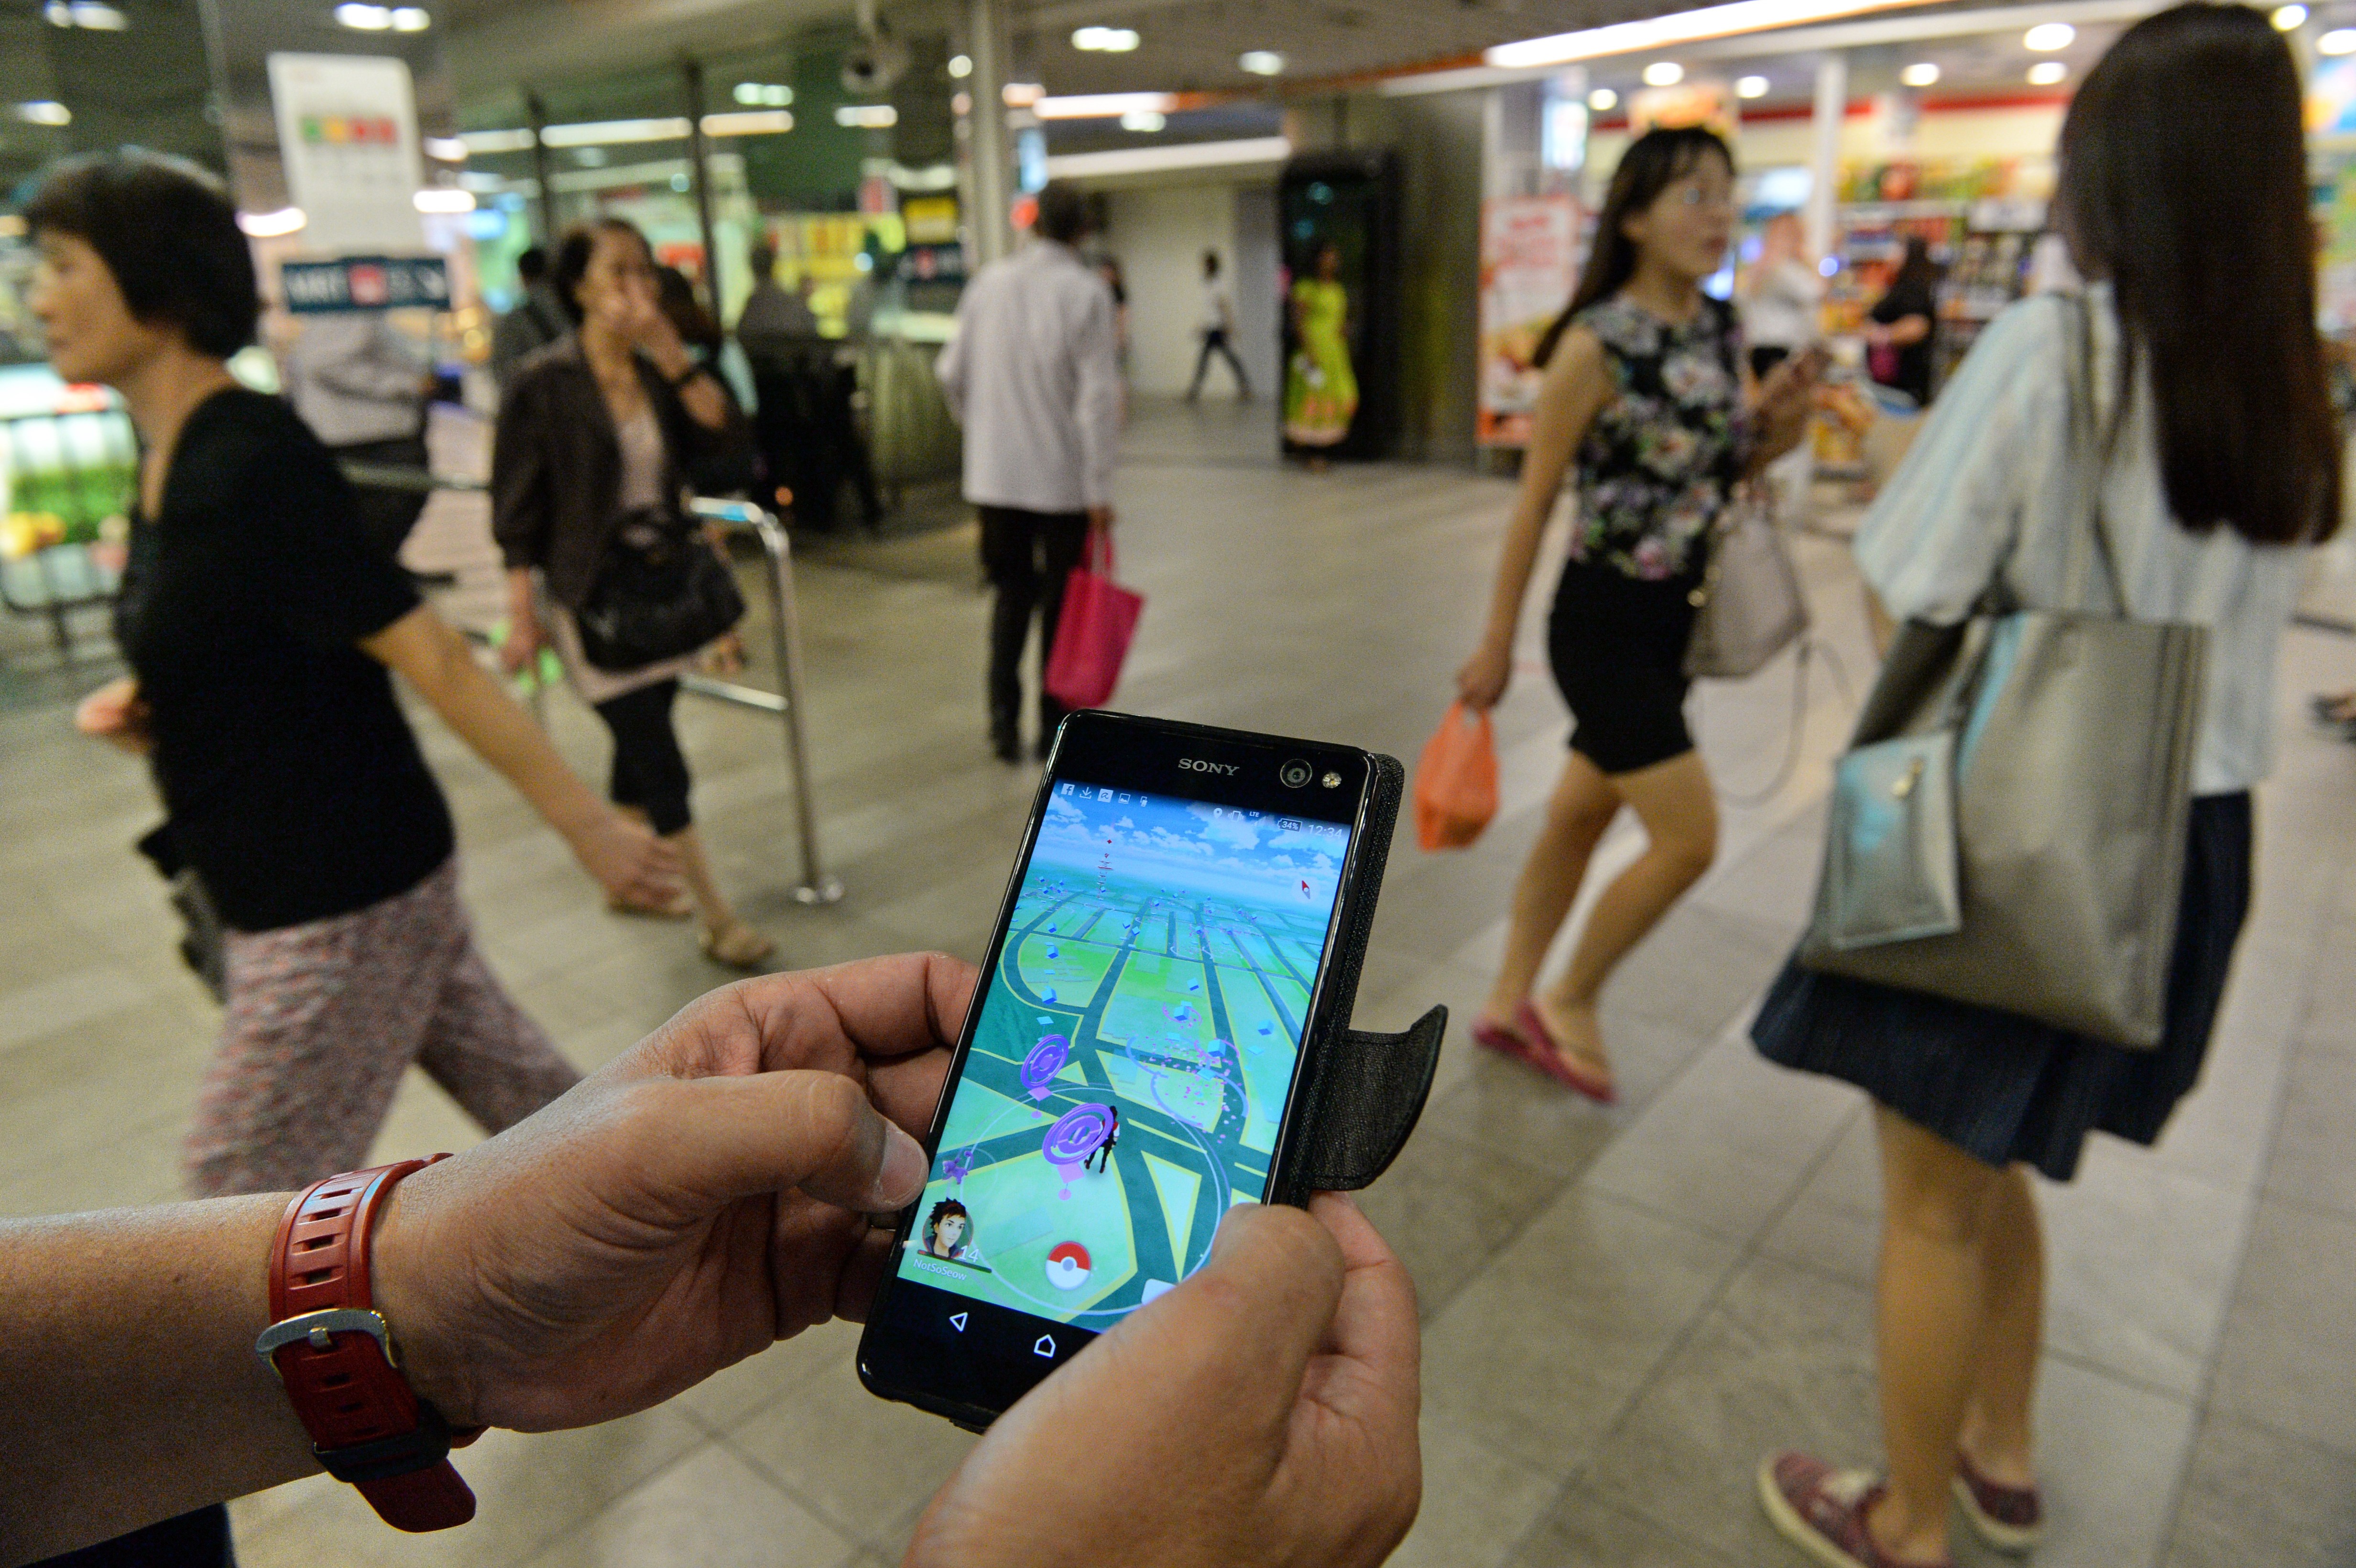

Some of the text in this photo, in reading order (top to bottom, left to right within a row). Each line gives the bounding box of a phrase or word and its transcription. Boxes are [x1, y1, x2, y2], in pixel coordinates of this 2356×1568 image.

[1178, 758, 1240, 776] SONY
[1282, 820, 1298, 830] 34%
[1308, 824, 1342, 838] 12:34
[959, 1245, 980, 1263] 14
[913, 1258, 967, 1281] NotSoSeow
